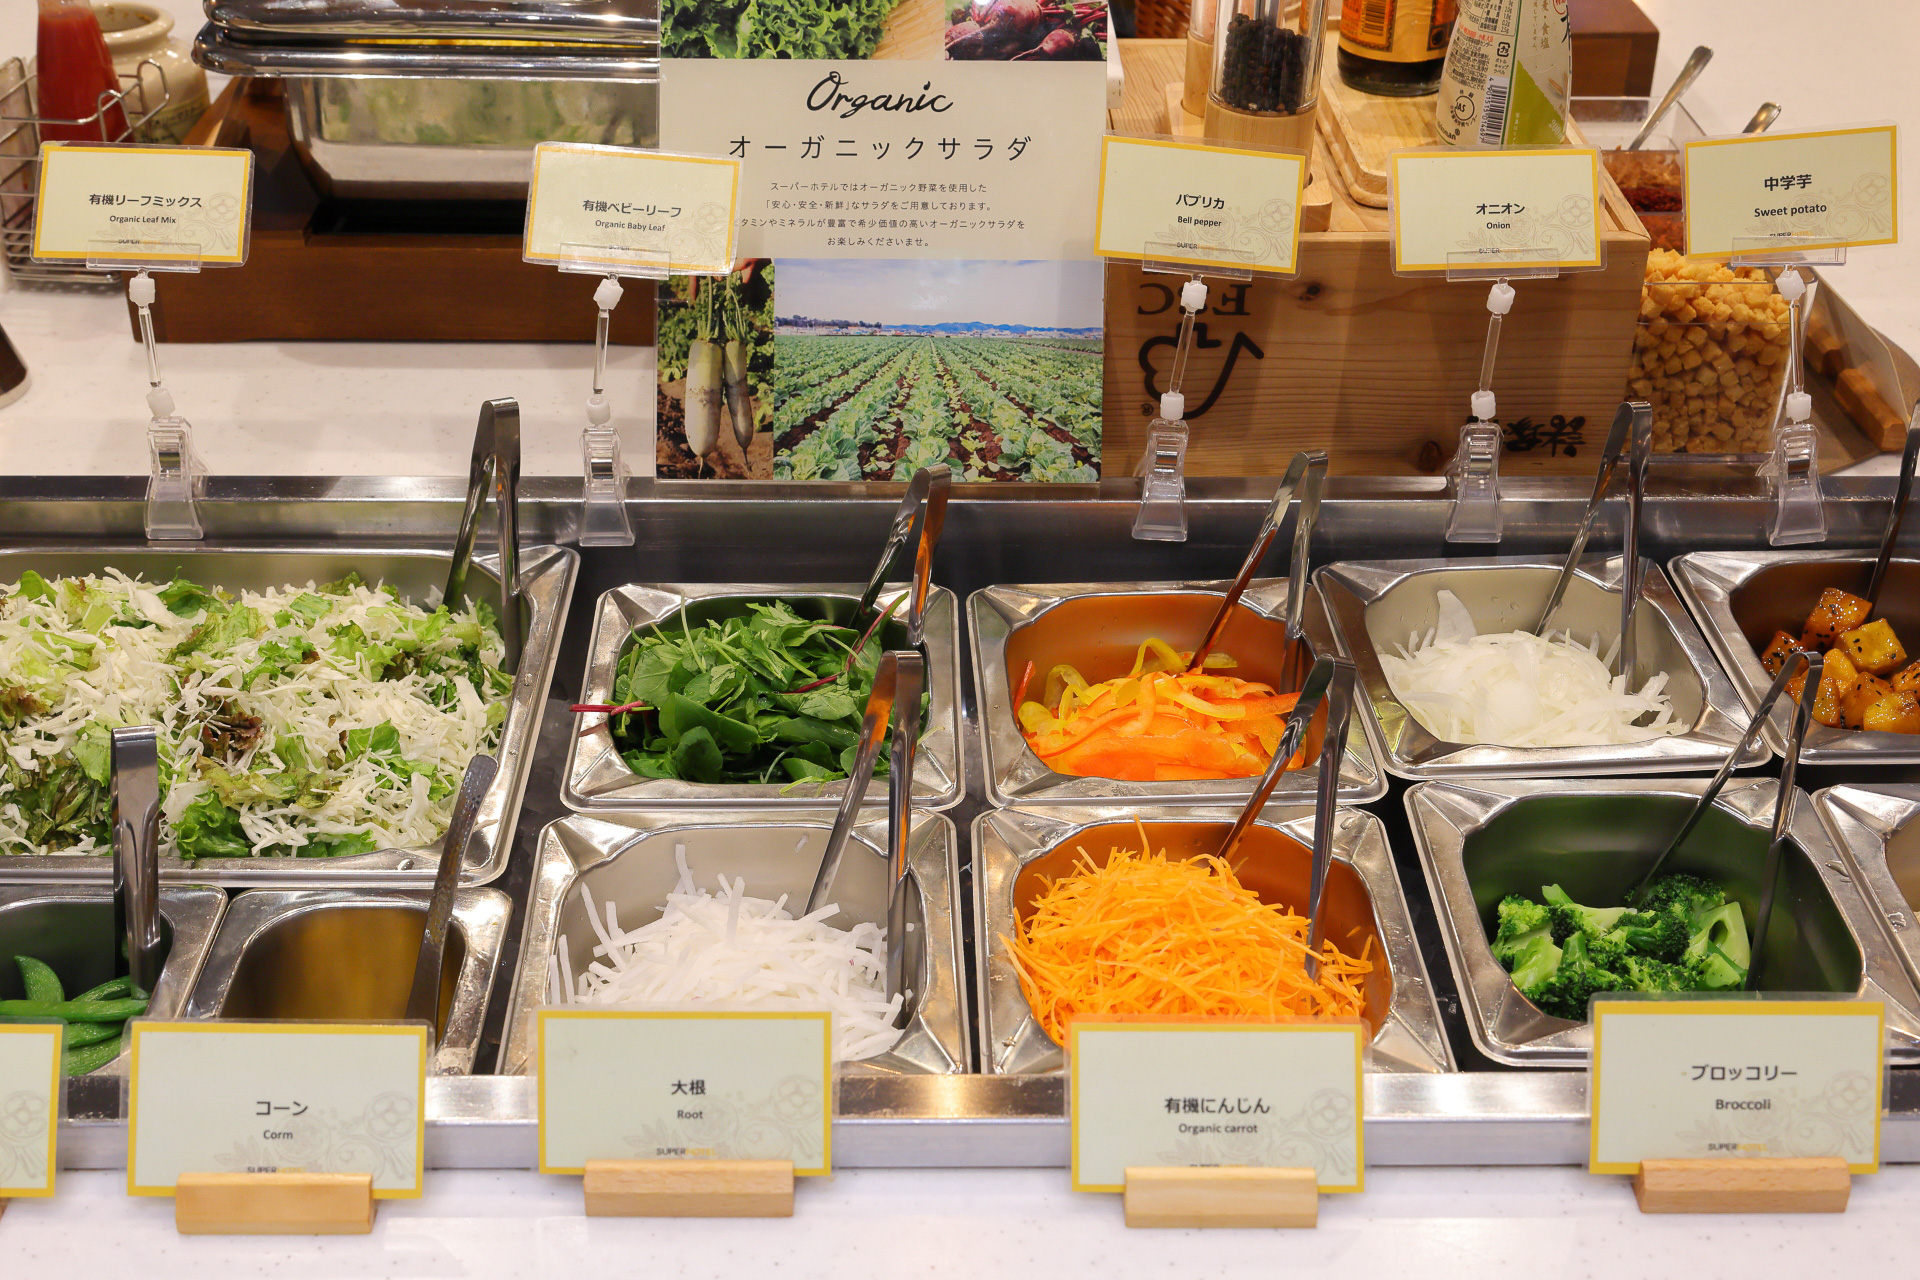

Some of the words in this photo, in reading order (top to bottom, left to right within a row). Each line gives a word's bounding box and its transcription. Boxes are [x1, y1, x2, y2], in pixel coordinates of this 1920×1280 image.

[806, 71, 954, 119] Organic
[729, 135, 1032, 161] オーガニックサラダ
[770, 181, 987, 193] スーパーホテルではオーガニック野菜を使用した
[1764, 174, 1812, 192] 中学芋
[89, 194, 202, 208] 有機リーフミックス
[1175, 194, 1225, 210] パプリカ
[582, 199, 682, 218] 有機ベビーリーフ
[1475, 202, 1526, 215] オニオン
[1754, 206, 1788, 218] Sweet
[1790, 203, 1827, 217] potato
[109, 215, 140, 224] Organic
[161, 216, 177, 224] Mix
[595, 219, 626, 229] Organic
[627, 222, 647, 231] Baby
[648, 224, 666, 232] Leaf
[733, 218, 1025, 230] タミンやミネラルが豊富で希少価値の高いオーガニックサラダを
[1177, 215, 1192, 224] Bell
[1193, 217, 1222, 227] pepper
[1486, 222, 1511, 230] Onion
[827, 237, 929, 247] お楽しみくださいませ。
[1691, 1064, 1797, 1081] ブロッコリー
[671, 1079, 706, 1095] 大根
[255, 1100, 309, 1116] コーン
[1164, 1097, 1270, 1114] 有機にんじん
[1715, 1098, 1771, 1110] Broccoli
[677, 1109, 703, 1119] Root
[1178, 1123, 1221, 1135] Organic
[1224, 1124, 1258, 1133] carrot
